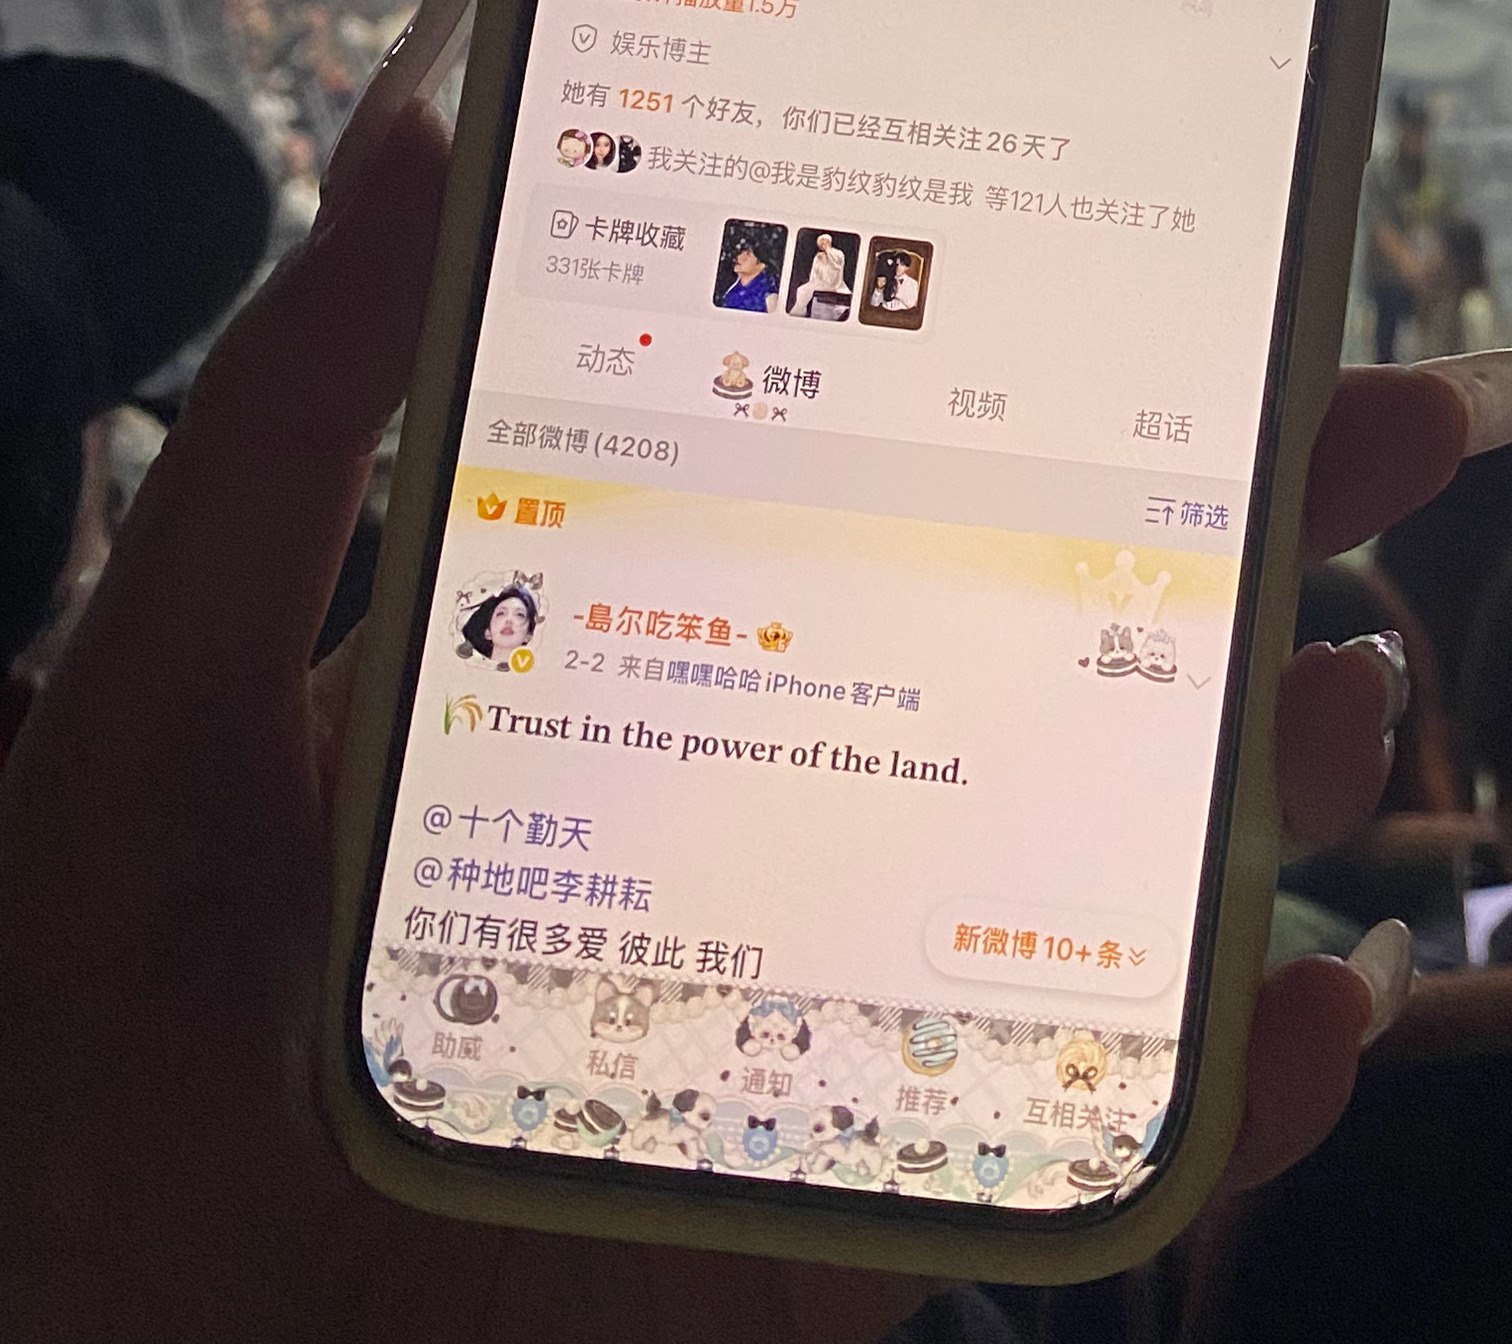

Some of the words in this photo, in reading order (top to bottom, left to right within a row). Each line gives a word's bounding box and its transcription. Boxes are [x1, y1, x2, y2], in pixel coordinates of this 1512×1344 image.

[609, 29, 712, 66] 娱乐博主
[560, 78, 611, 108] 她有
[618, 87, 674, 114] 1251
[584, 215, 688, 253] 卡牌收藏
[984, 184, 1197, 235] 等121人也关注了她
[545, 255, 646, 288] 331张卡牌
[575, 342, 637, 377] 动态
[761, 364, 823, 400] 微博
[947, 386, 1009, 423] 视频
[1132, 408, 1194, 445] 超话
[486, 418, 680, 468] 全部微博(4208)
[1178, 500, 1230, 532] 筛选
[513, 496, 567, 529] 置顶
[563, 649, 605, 673] 2-2
[486, 703, 573, 741] Trust
[581, 714, 613, 745] in
[621, 720, 673, 752] the
[678, 730, 784, 765] power
[790, 740, 826, 770] of
[830, 745, 882, 776] the
[888, 750, 970, 787] land.
[422, 803, 594, 853] @十个勤天
[412, 855, 654, 914] @种地吧李耕耘
[403, 905, 608, 964] 你们有很多爱
[618, 929, 688, 971] 彼此
[695, 940, 764, 980] 我们
[952, 922, 1125, 970] 新微博10+条
[431, 1031, 484, 1062] 助威
[585, 1050, 640, 1082] 私信
[740, 1065, 794, 1098] 通知
[895, 1083, 949, 1117] 推荐
[1022, 1095, 1130, 1135] 互相关注
